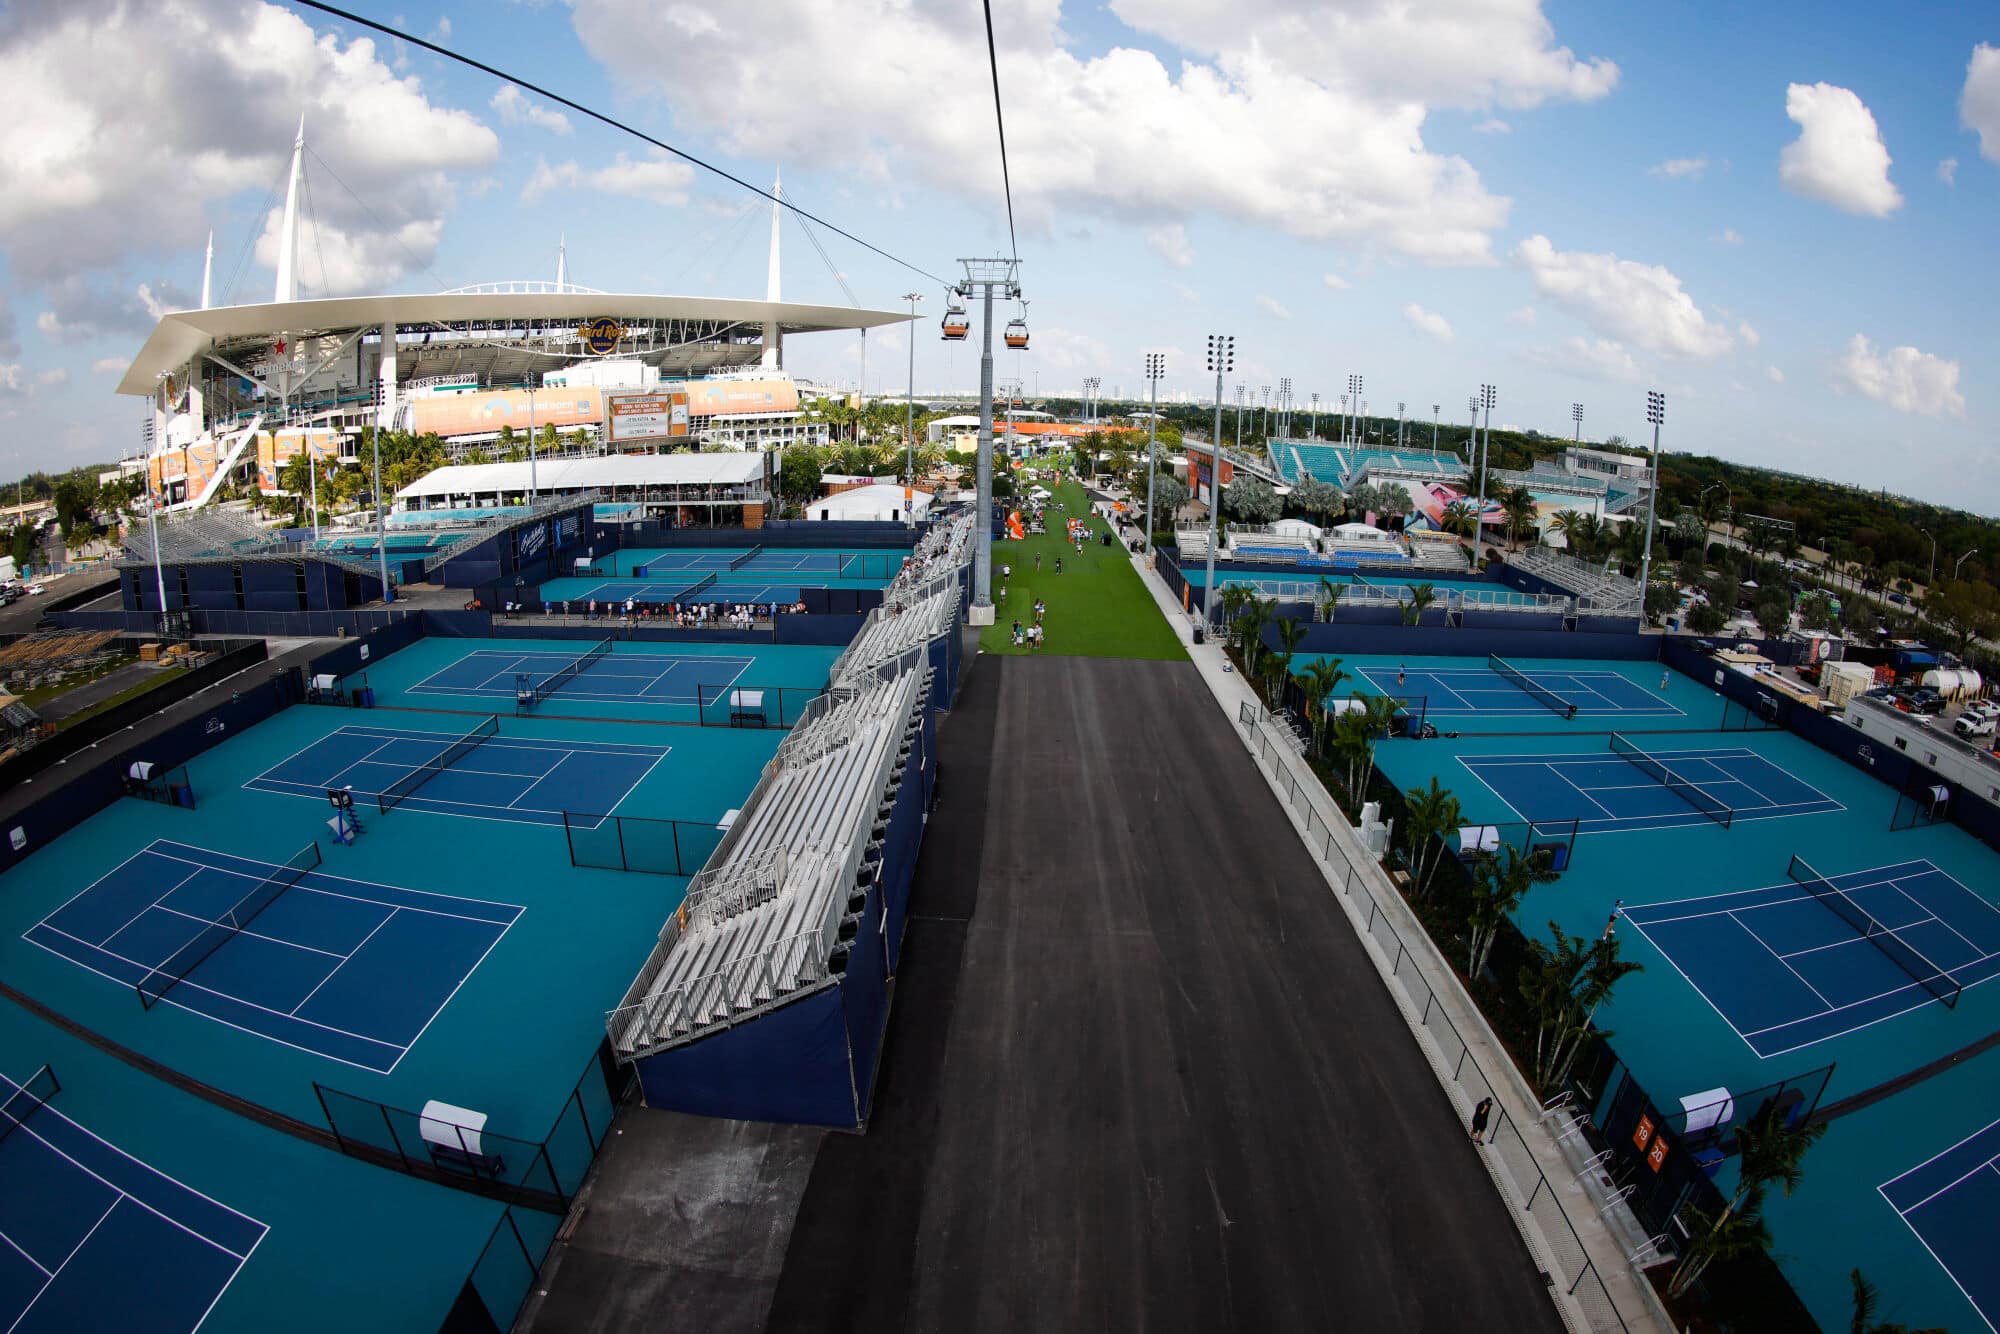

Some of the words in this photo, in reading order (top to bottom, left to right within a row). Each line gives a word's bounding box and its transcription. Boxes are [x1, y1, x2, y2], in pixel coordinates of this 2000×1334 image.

[577, 324, 605, 338] Hard
[605, 324, 629, 341] Rock
[1638, 1126, 1648, 1141] 19
[1651, 1146, 1663, 1162] 20
